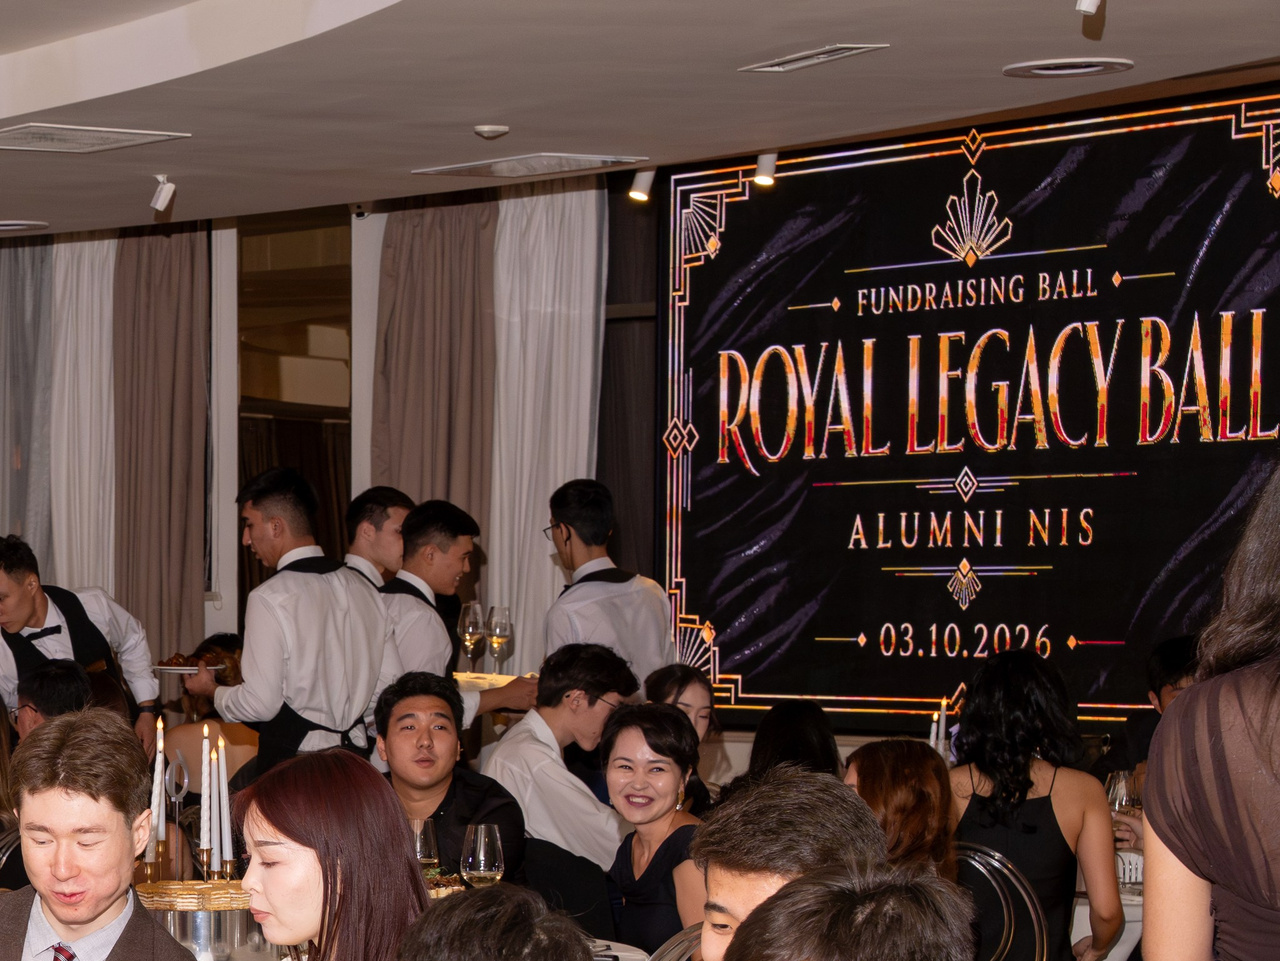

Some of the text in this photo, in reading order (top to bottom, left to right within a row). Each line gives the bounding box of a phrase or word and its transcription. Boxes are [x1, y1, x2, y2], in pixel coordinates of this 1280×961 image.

[857, 268, 1098, 316] FUNDRAISING BALL
[717, 308, 1280, 477] ROYAL LEGACY BALL
[847, 508, 1094, 549] ALUMNI NIS
[879, 622, 1052, 660] 03.10.2026
